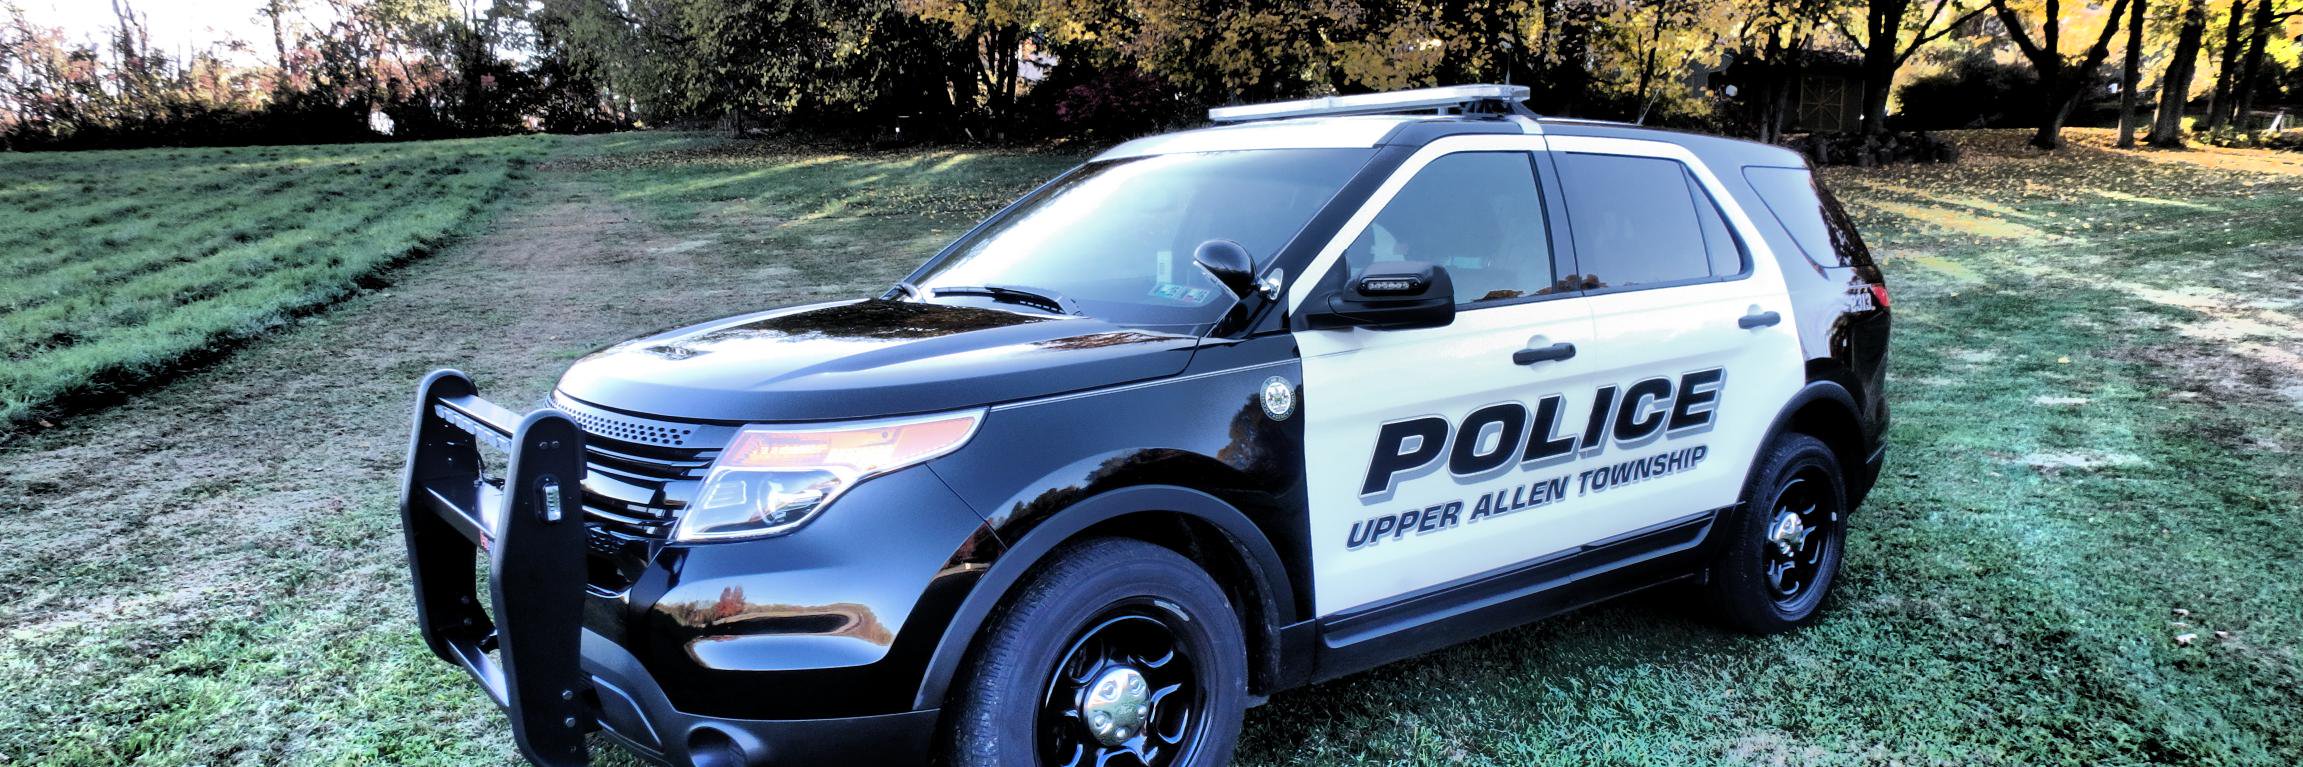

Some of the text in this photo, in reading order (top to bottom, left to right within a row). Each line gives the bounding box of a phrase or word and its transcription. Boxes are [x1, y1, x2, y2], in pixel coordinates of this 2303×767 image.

[1359, 366, 1728, 504] POLICE
[1346, 445, 1708, 550] UPPER ALLEN TOWNSHIP
